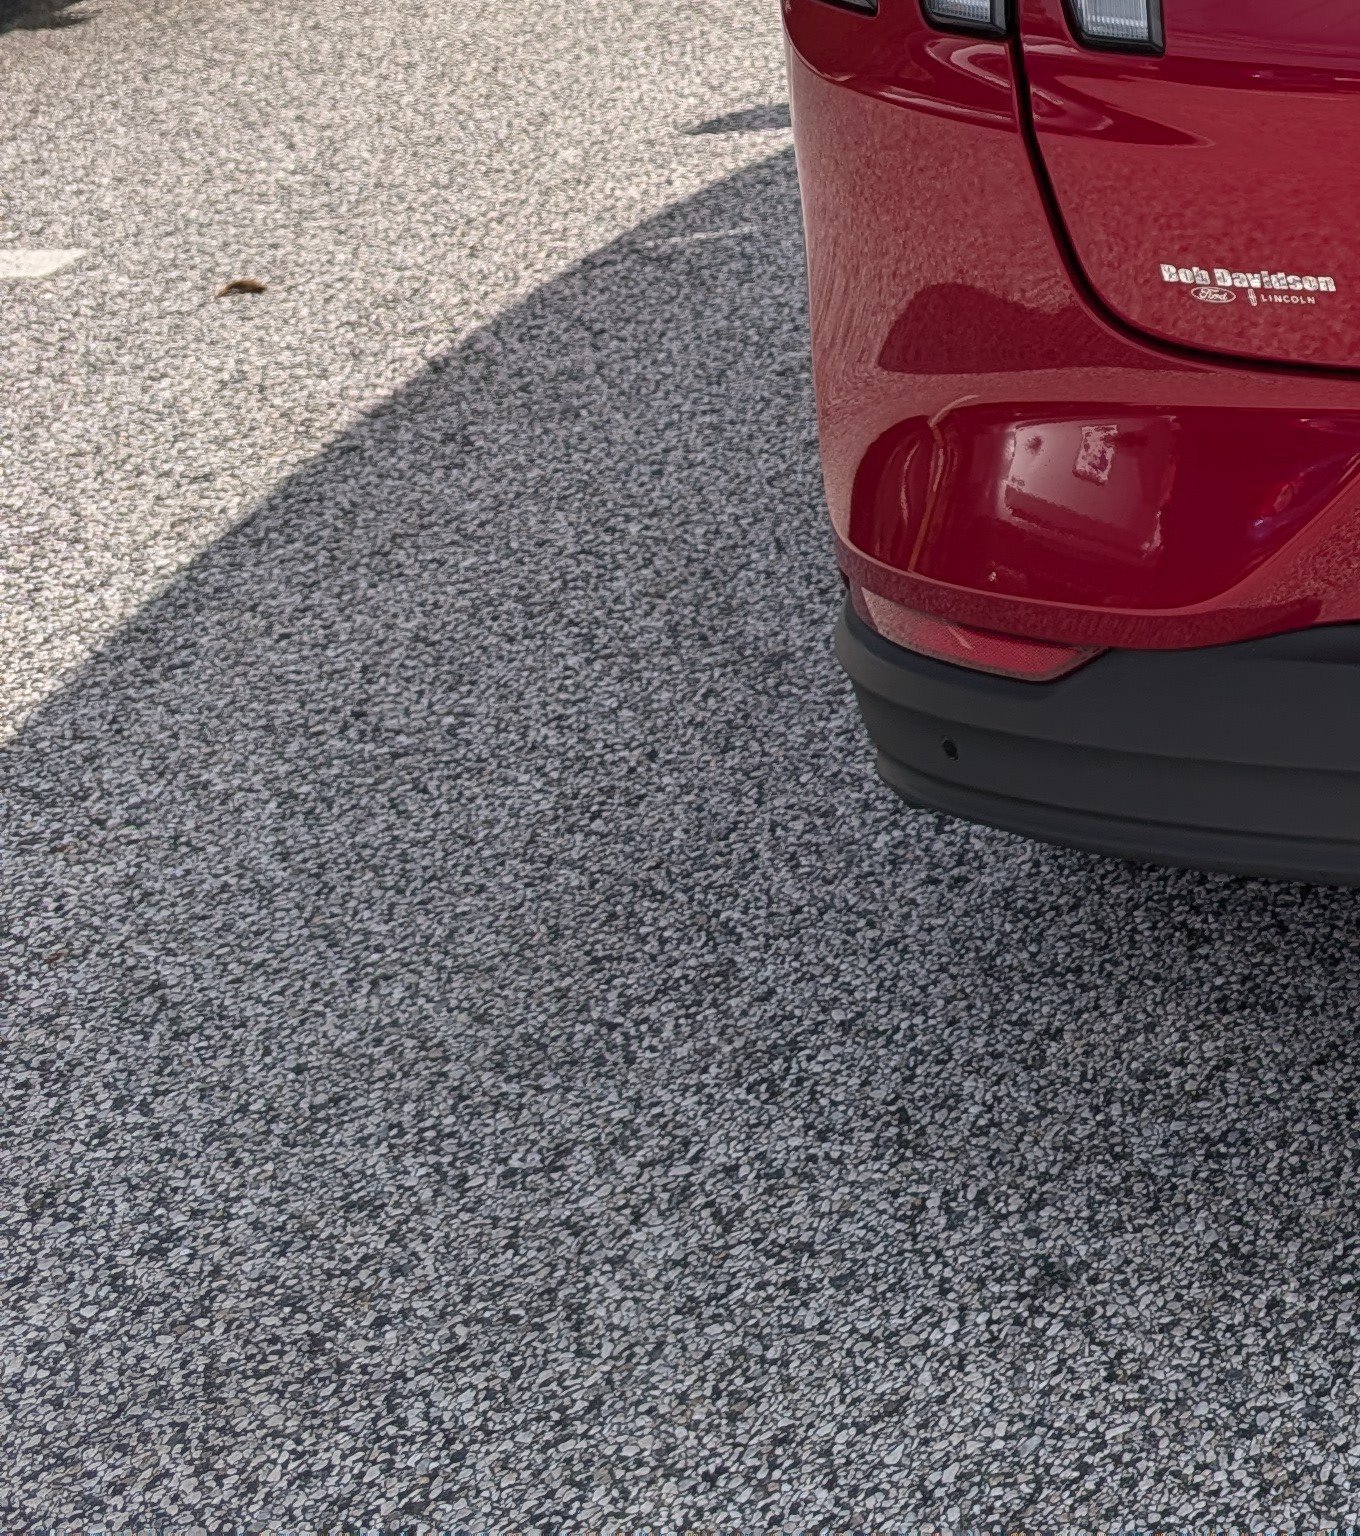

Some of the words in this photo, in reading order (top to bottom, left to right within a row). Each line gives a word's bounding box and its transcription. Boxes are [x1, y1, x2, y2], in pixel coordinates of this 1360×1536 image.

[1160, 264, 1211, 285] Bob
[1213, 268, 1336, 292] Davidson
[1260, 293, 1316, 305] LINCOLN
